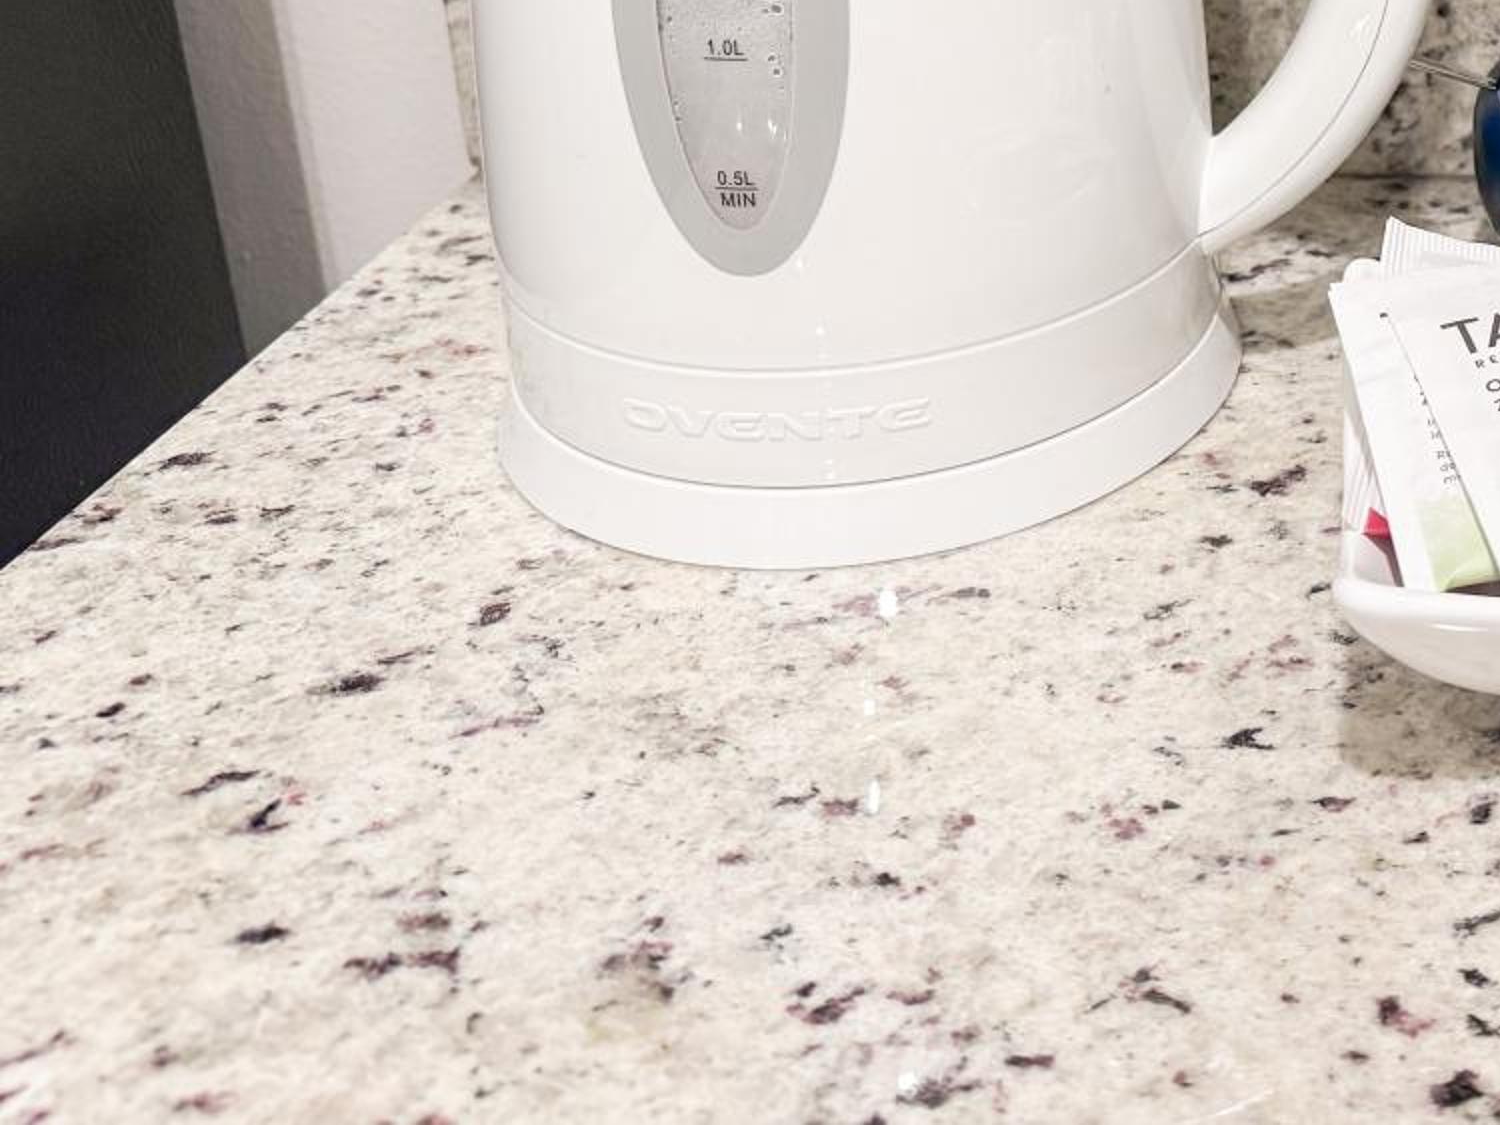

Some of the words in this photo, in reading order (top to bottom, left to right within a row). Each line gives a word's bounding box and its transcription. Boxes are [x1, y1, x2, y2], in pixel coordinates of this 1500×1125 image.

[708, 39, 745, 56] 1.0L
[717, 170, 757, 186] 0.5L
[720, 192, 757, 208] MIN
[622, 396, 931, 443] OVENTE
